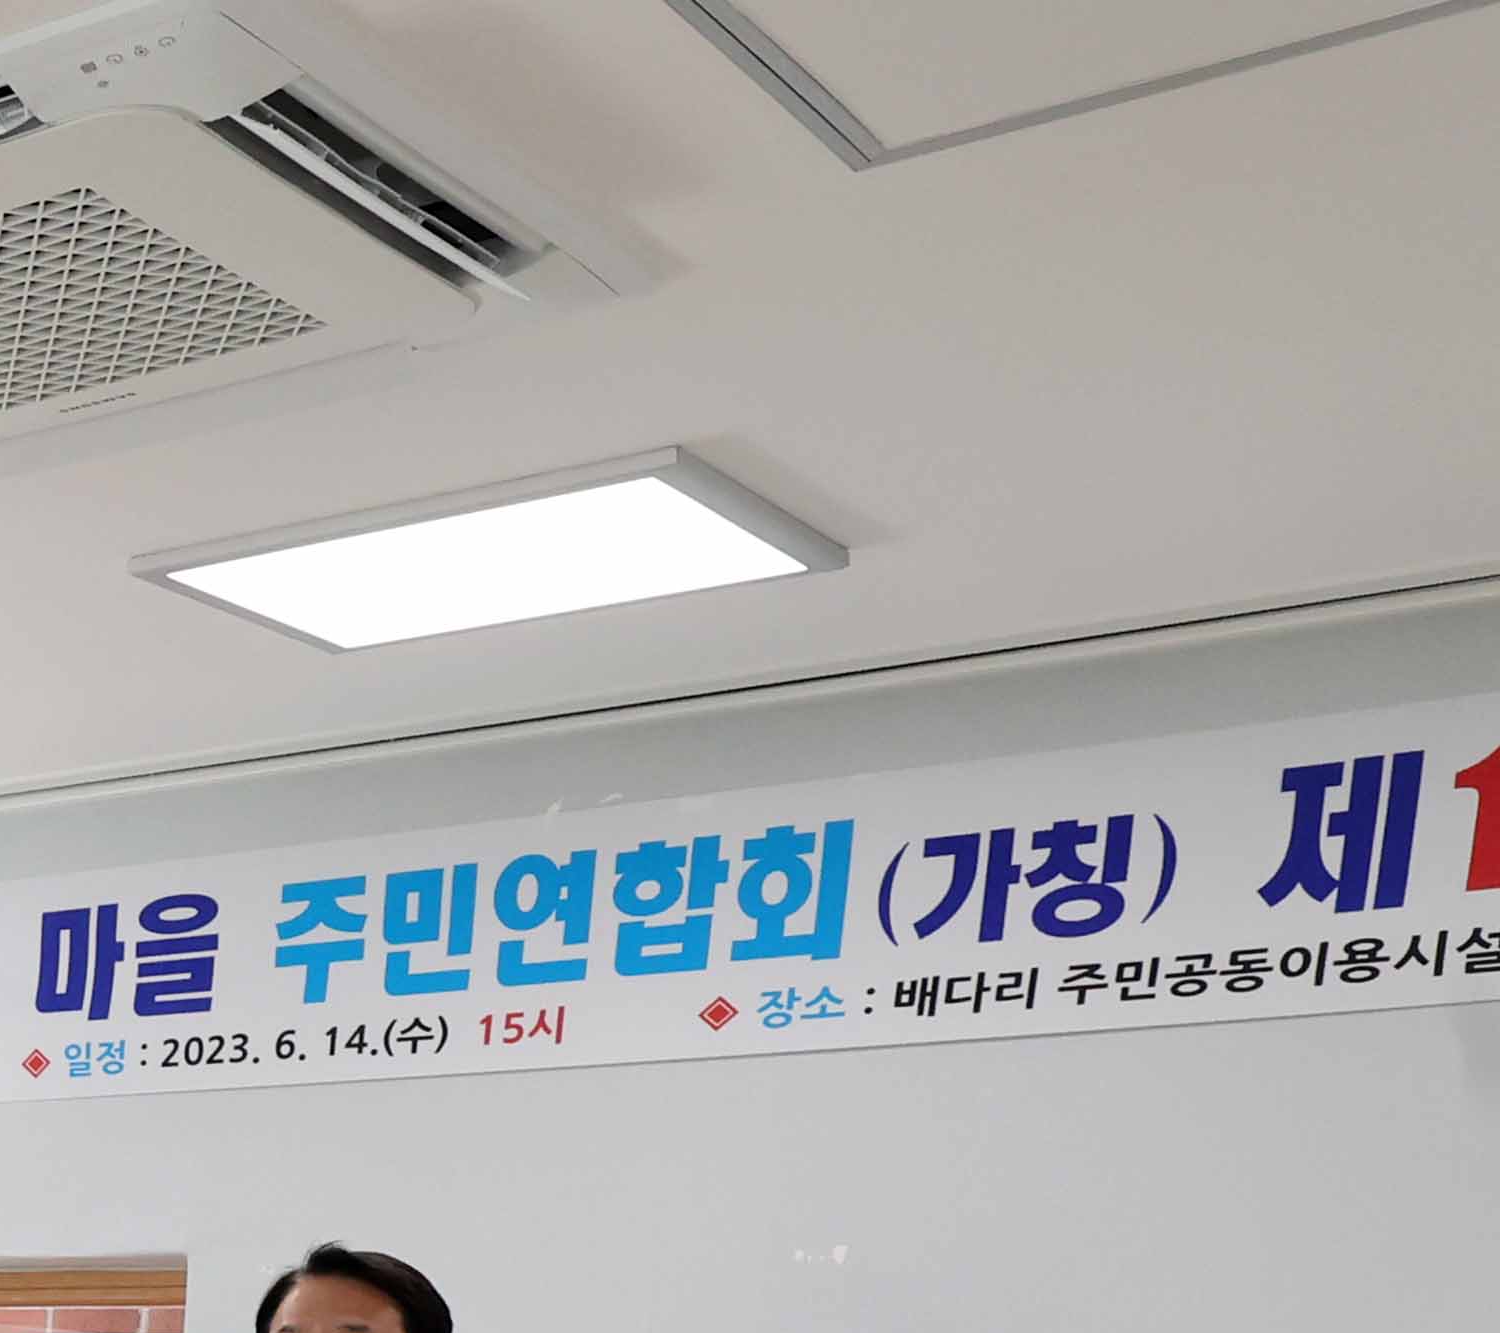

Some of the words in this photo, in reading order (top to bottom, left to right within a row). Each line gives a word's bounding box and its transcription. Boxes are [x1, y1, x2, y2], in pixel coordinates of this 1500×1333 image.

[35, 892, 220, 1022] 마을
[757, 985, 847, 1031] 장소
[892, 966, 1038, 1019] 배다리
[62, 1038, 128, 1081] 일정
[161, 1032, 261, 1071] 2023.
[476, 1005, 567, 1049] 15시
